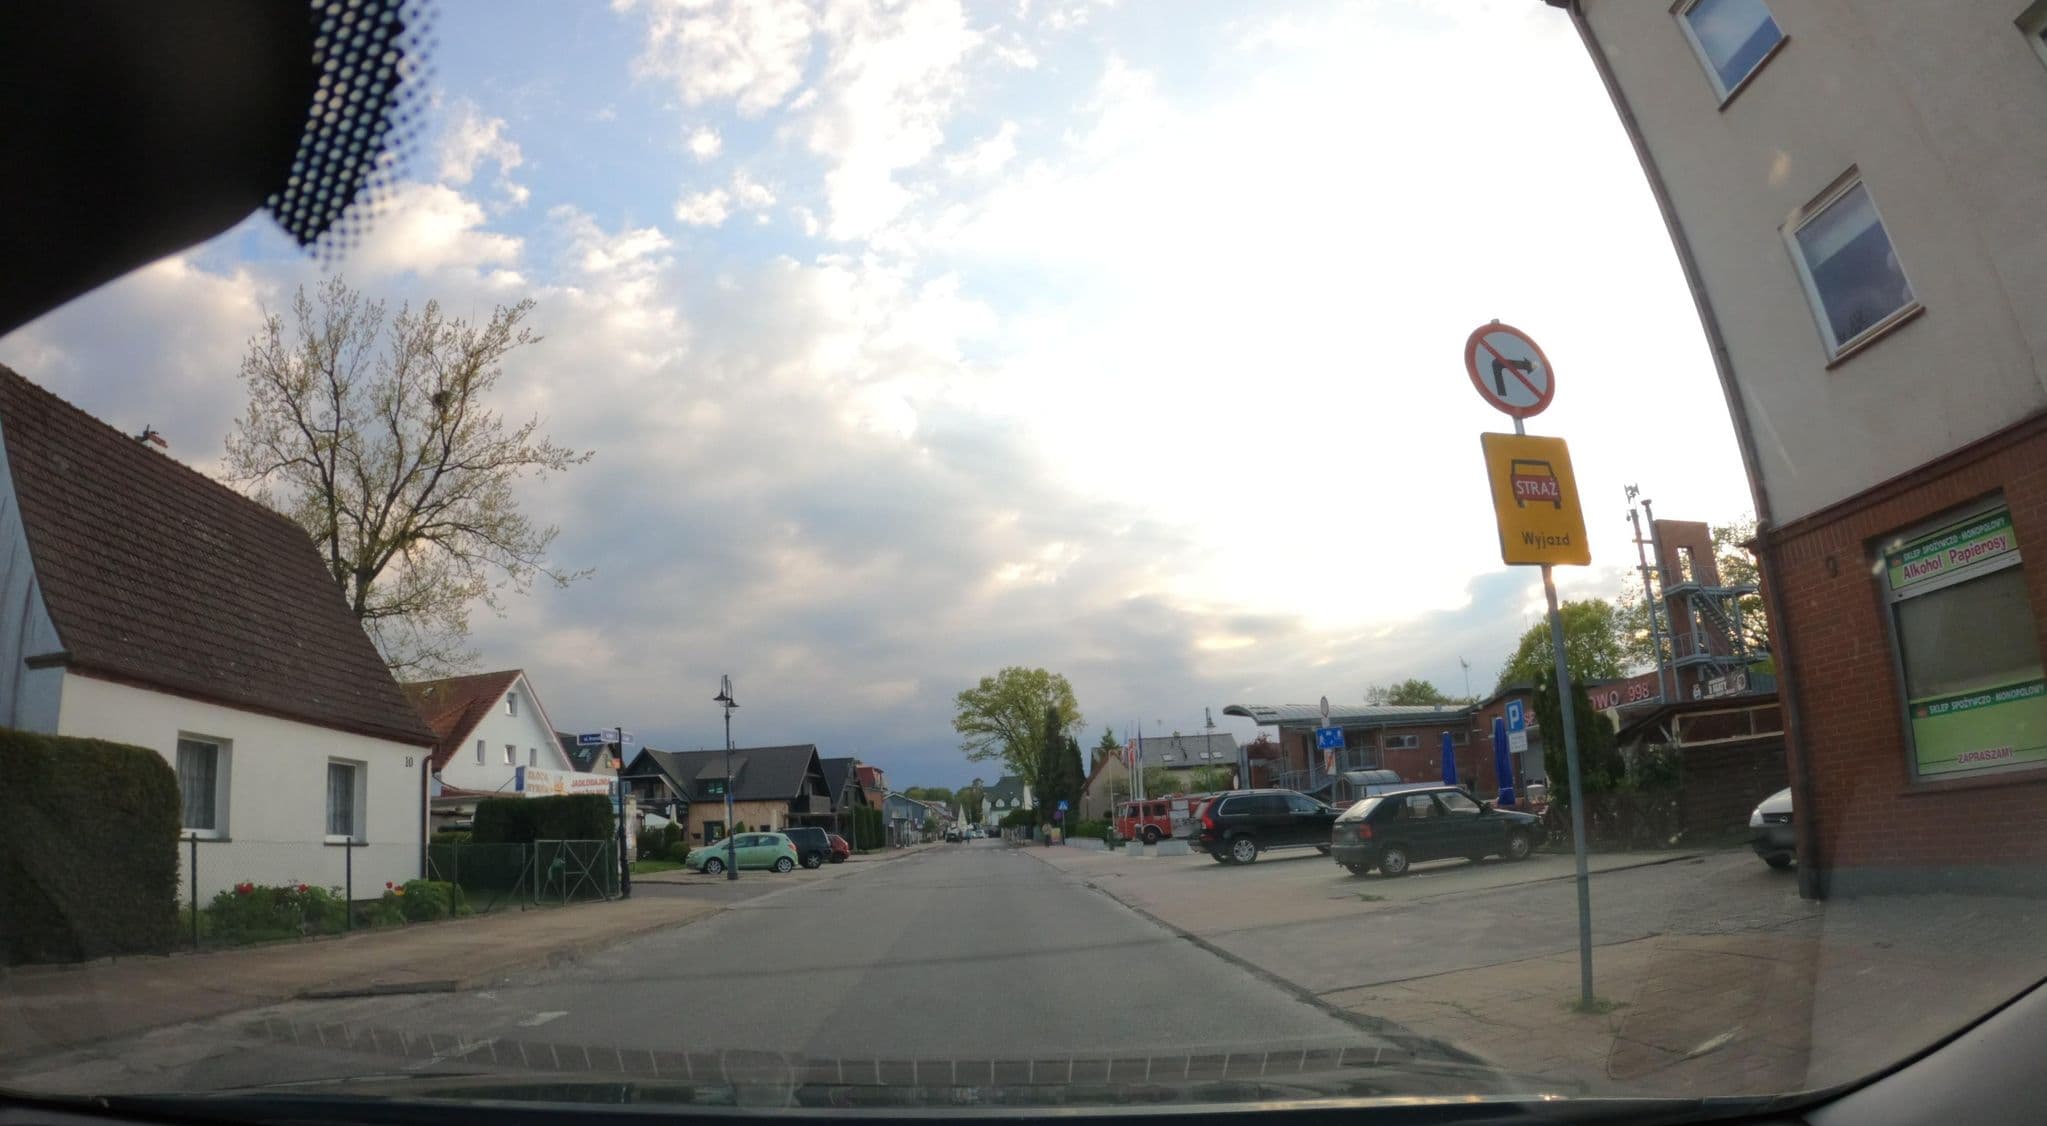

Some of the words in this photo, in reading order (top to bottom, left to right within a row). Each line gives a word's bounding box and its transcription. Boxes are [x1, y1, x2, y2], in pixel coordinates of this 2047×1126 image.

[1516, 478, 1558, 496] STRAŻ
[1521, 531, 1570, 549] Wyjazd
[1903, 548, 1921, 562] SKLEP
[1903, 553, 1943, 580] Alkohol
[1948, 534, 2007, 564] Papierosy
[1629, 682, 1649, 702] 998
[1928, 703, 1949, 714] SKLEP
[405, 756, 414, 768] 10
